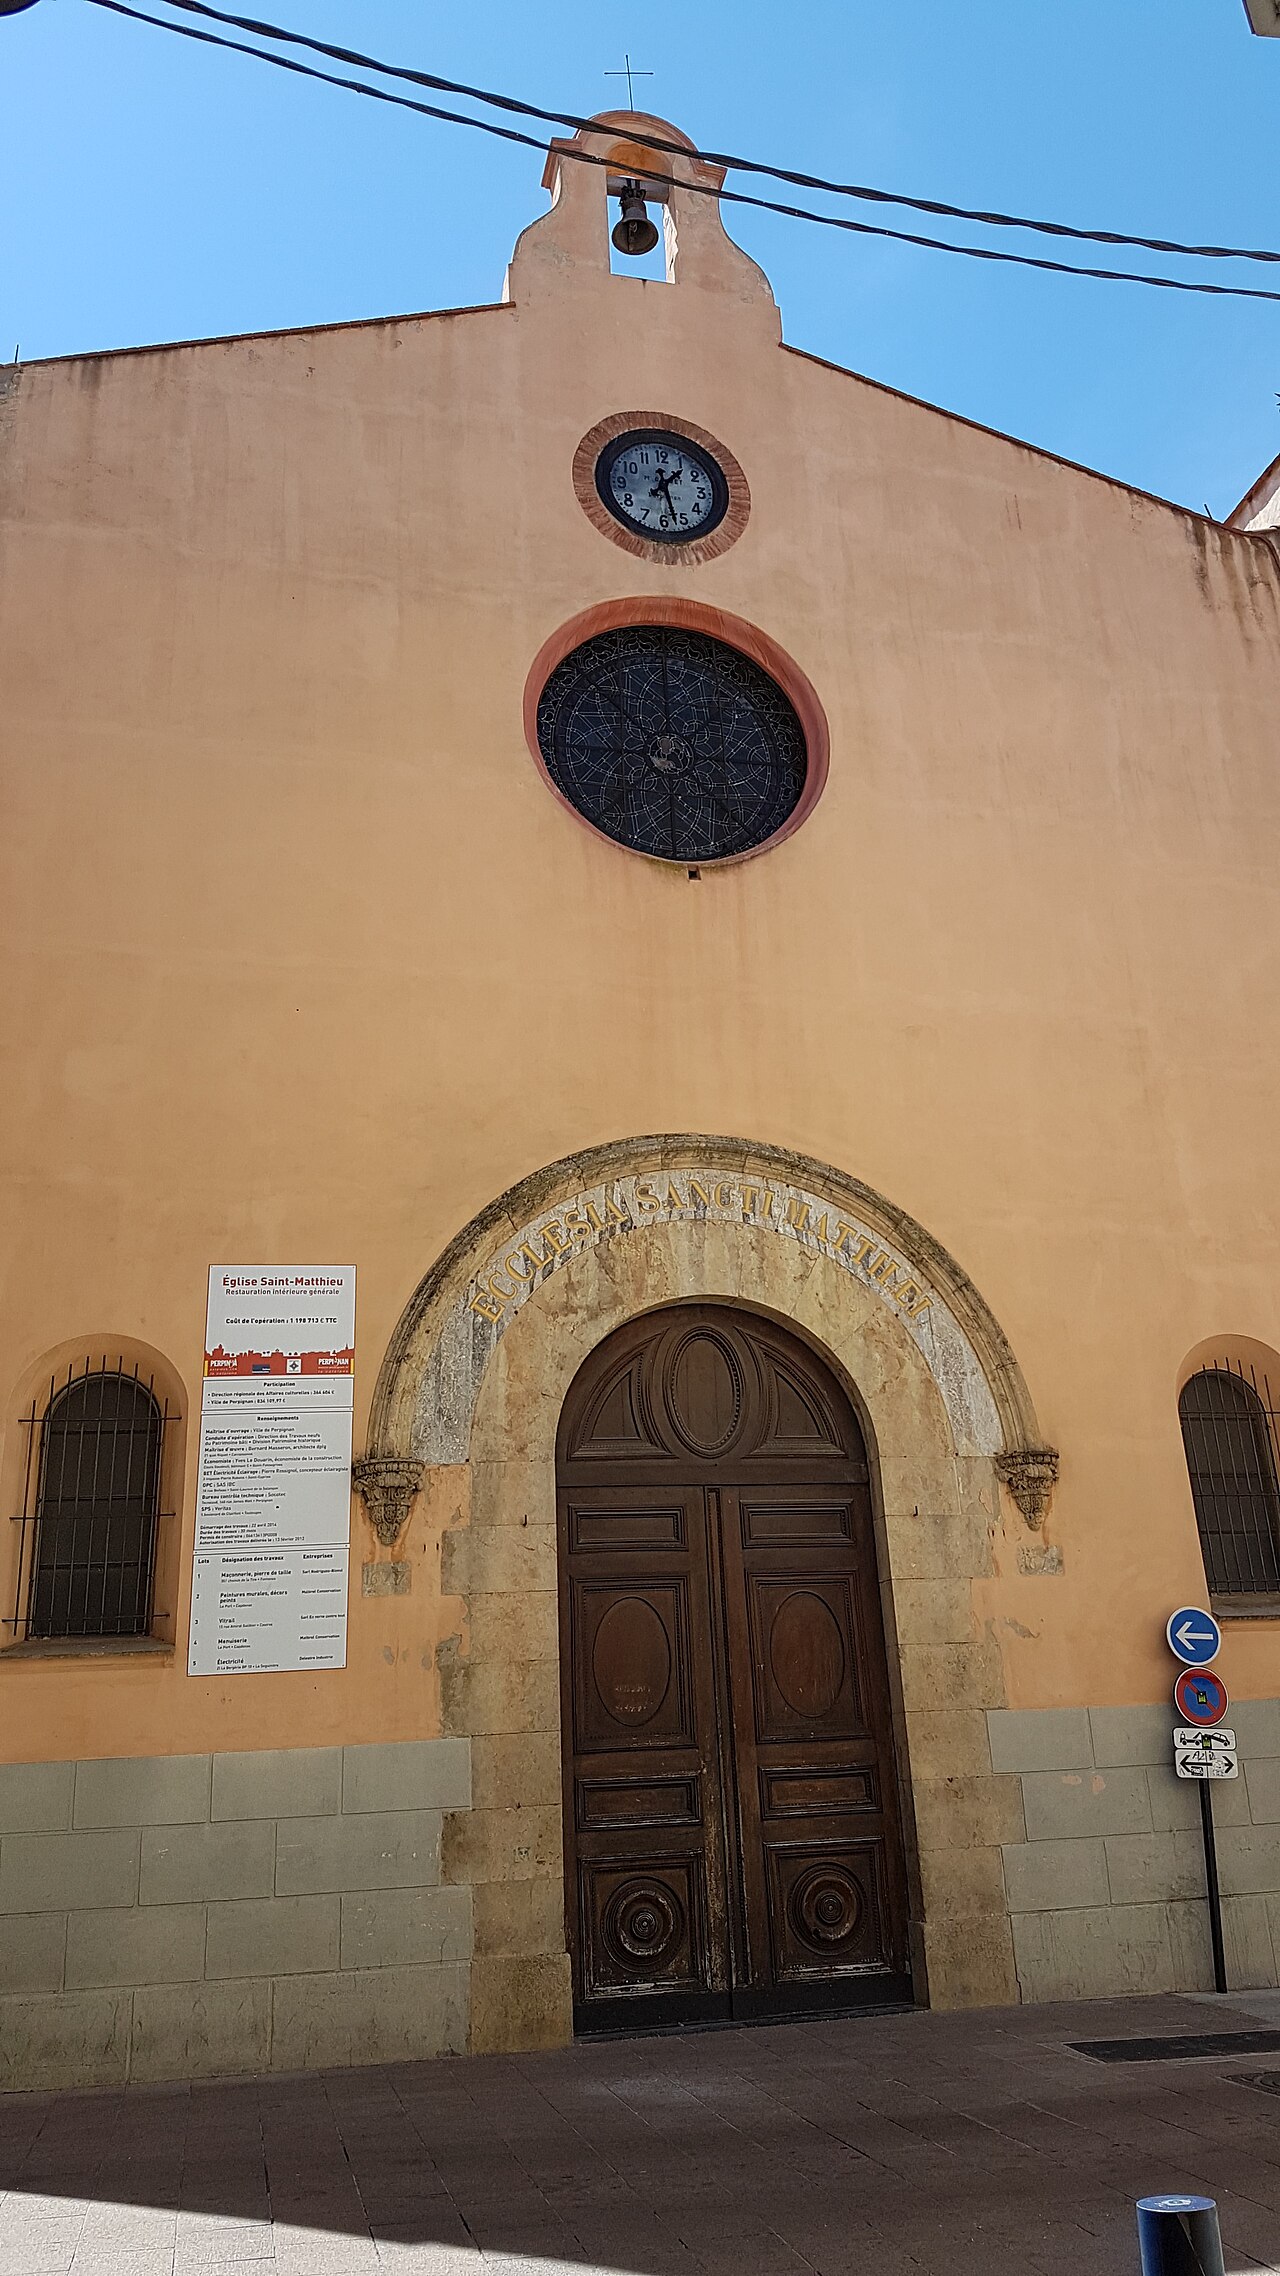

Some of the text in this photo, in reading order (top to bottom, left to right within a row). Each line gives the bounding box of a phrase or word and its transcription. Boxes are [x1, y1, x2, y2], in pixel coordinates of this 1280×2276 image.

[640, 452, 649, 464] 11
[655, 450, 668, 464] 12
[677, 451, 683, 468] 1
[624, 461, 638, 474] 10
[690, 470, 699, 482] 2
[617, 477, 626, 488] 9
[697, 487, 706, 499] 3
[624, 493, 633, 507] 8
[641, 508, 650, 520] 7
[692, 503, 702, 515] 4
[660, 514, 668, 527] 6
[680, 513, 688, 525] 5
[470, 1195, 628, 1325] ECCLESIA
[635, 1179, 775, 1218] SANCTI
[222, 1274, 343, 1288] Église Saint-Matthieu
[225, 1288, 340, 1296] Restauration intérieure générale
[251, 1317, 285, 1326] l'opération
